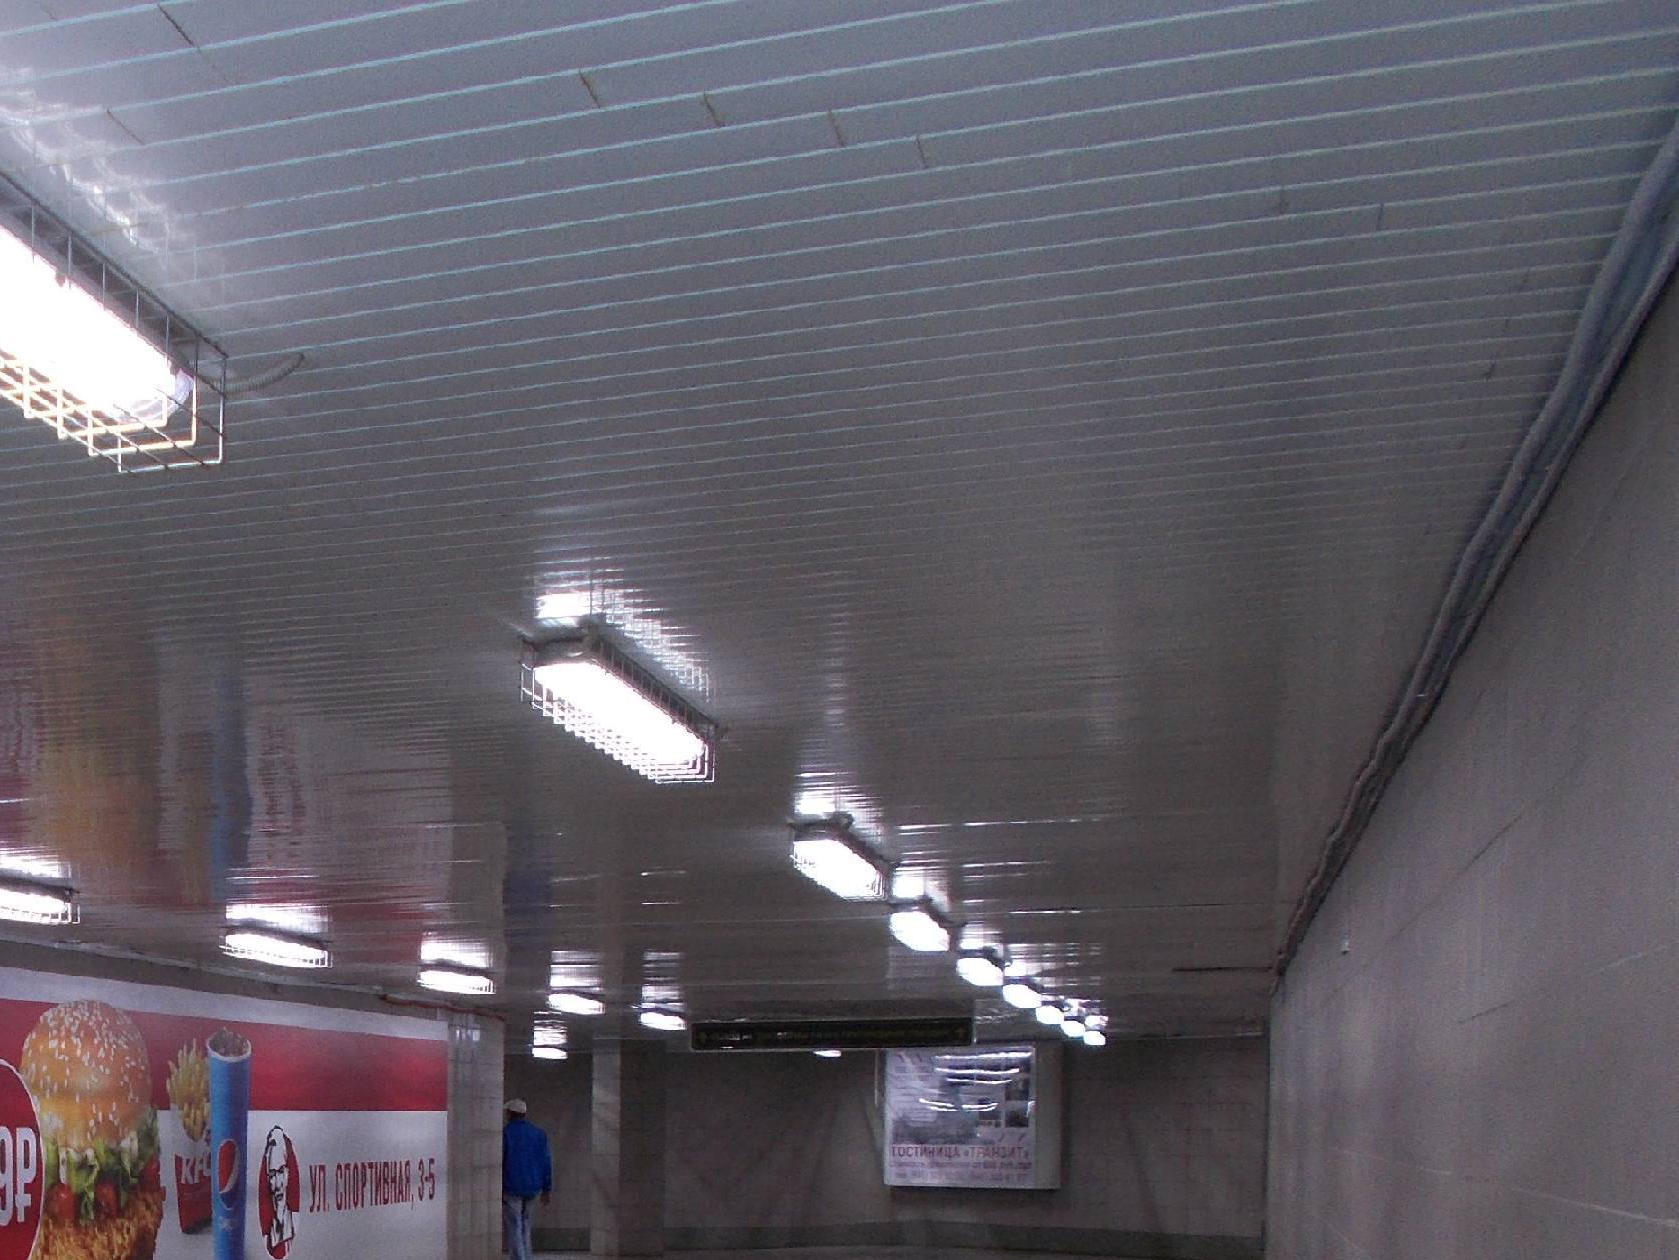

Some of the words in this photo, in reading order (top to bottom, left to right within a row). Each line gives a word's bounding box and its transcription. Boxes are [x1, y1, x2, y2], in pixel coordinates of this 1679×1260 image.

[892, 1145, 961, 1160] ГОСТИНИЦА
[309, 1164, 330, 1213] УЛ.
[335, 1160, 414, 1211] СПОРТИВНАЯ,
[418, 1158, 435, 1201] 3-5
